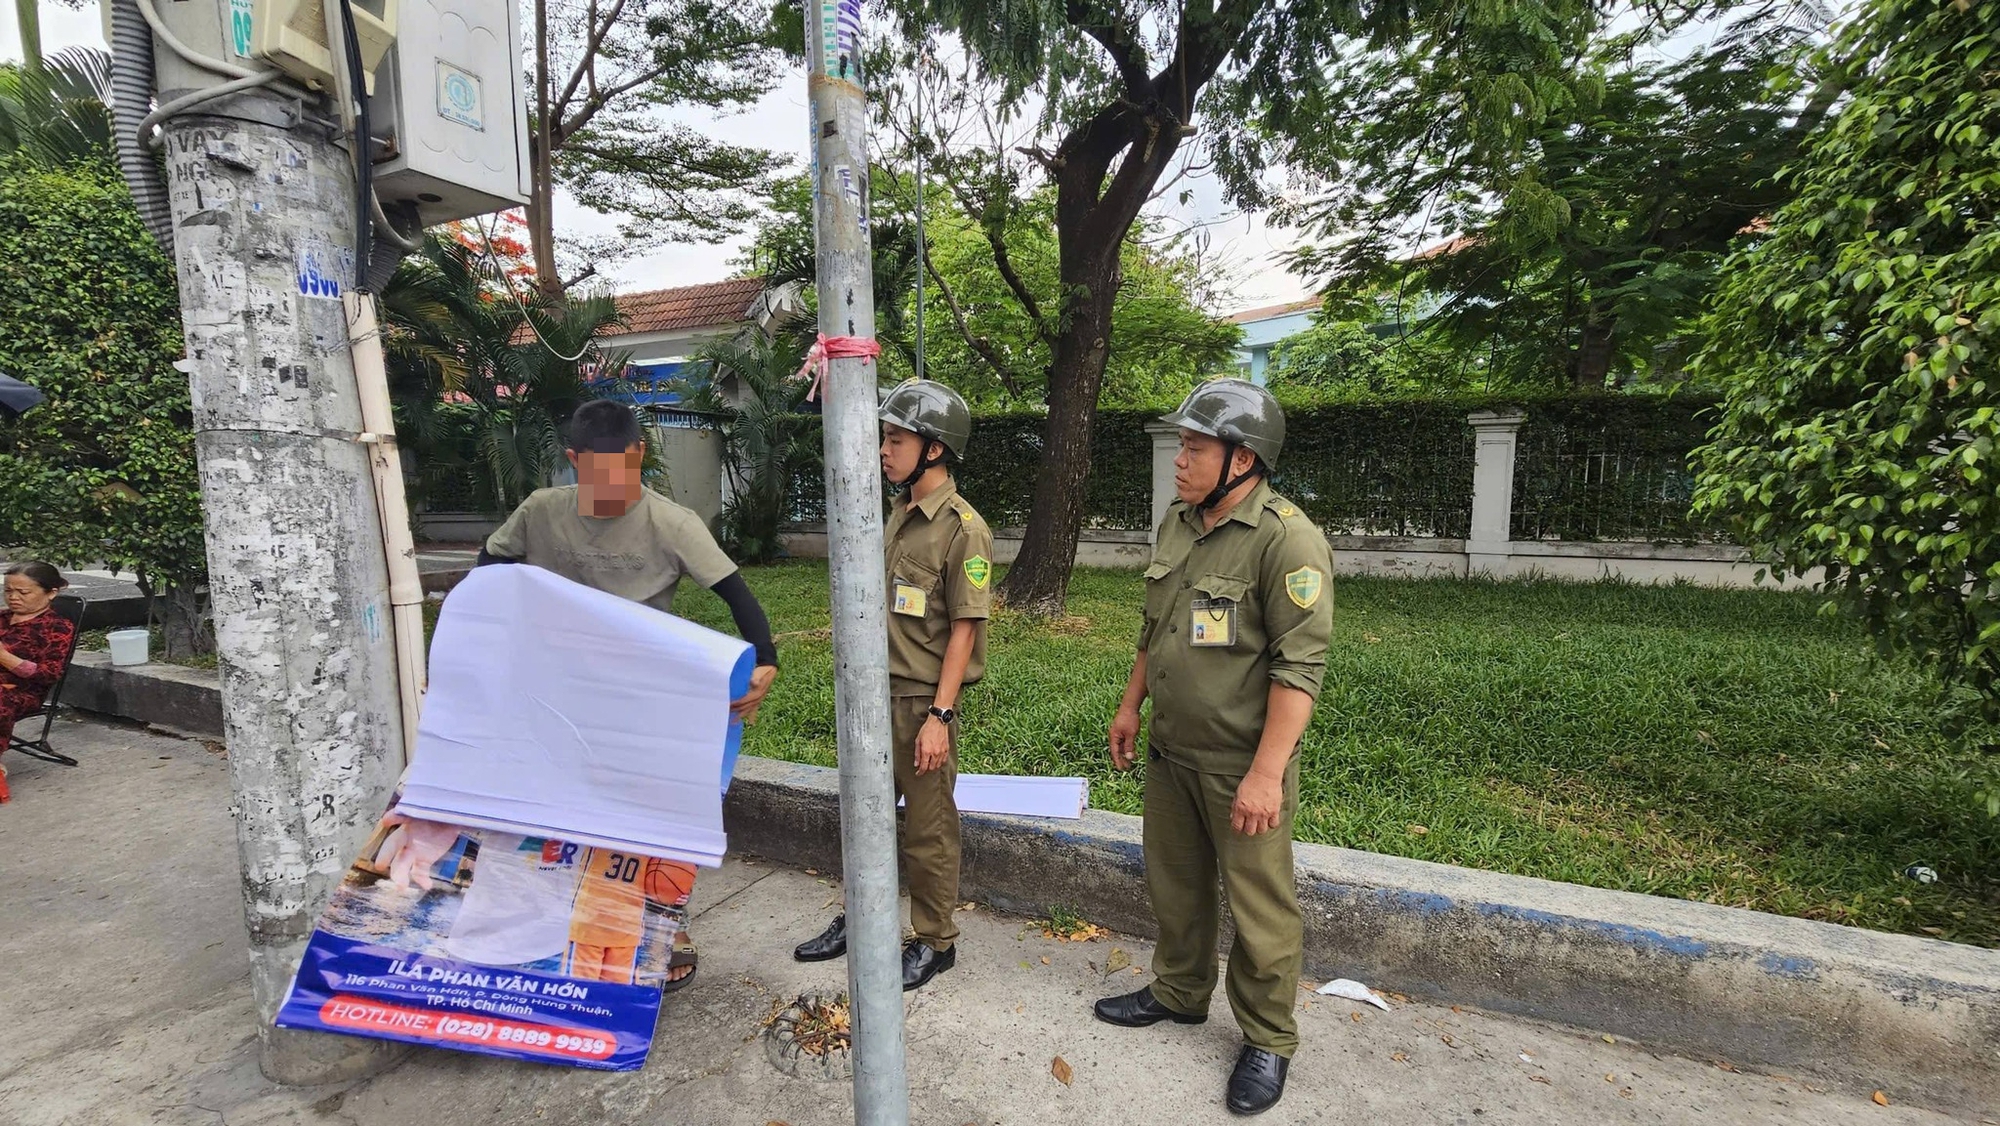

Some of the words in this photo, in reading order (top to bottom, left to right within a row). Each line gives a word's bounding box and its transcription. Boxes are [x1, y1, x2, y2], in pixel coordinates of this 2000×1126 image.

[604, 853, 640, 883] 30
[345, 973, 367, 986] 116
[368, 979, 406, 992] Phan
[410, 984, 437, 994] Văn
[475, 988, 487, 998] P.
[531, 997, 567, 1010] Hưng
[387, 959, 423, 980] ILA
[428, 966, 490, 988] PHAN
[495, 975, 539, 993] VĂN
[541, 982, 589, 1000] HỚN
[426, 994, 446, 1006] TP.
[472, 1000, 496, 1012] Chí
[499, 1003, 533, 1015] Minh
[330, 1002, 433, 1030] HOTLINE:
[436, 1016, 494, 1041] (028)
[497, 1026, 551, 1045] 8889
[554, 1034, 607, 1055] 9939
